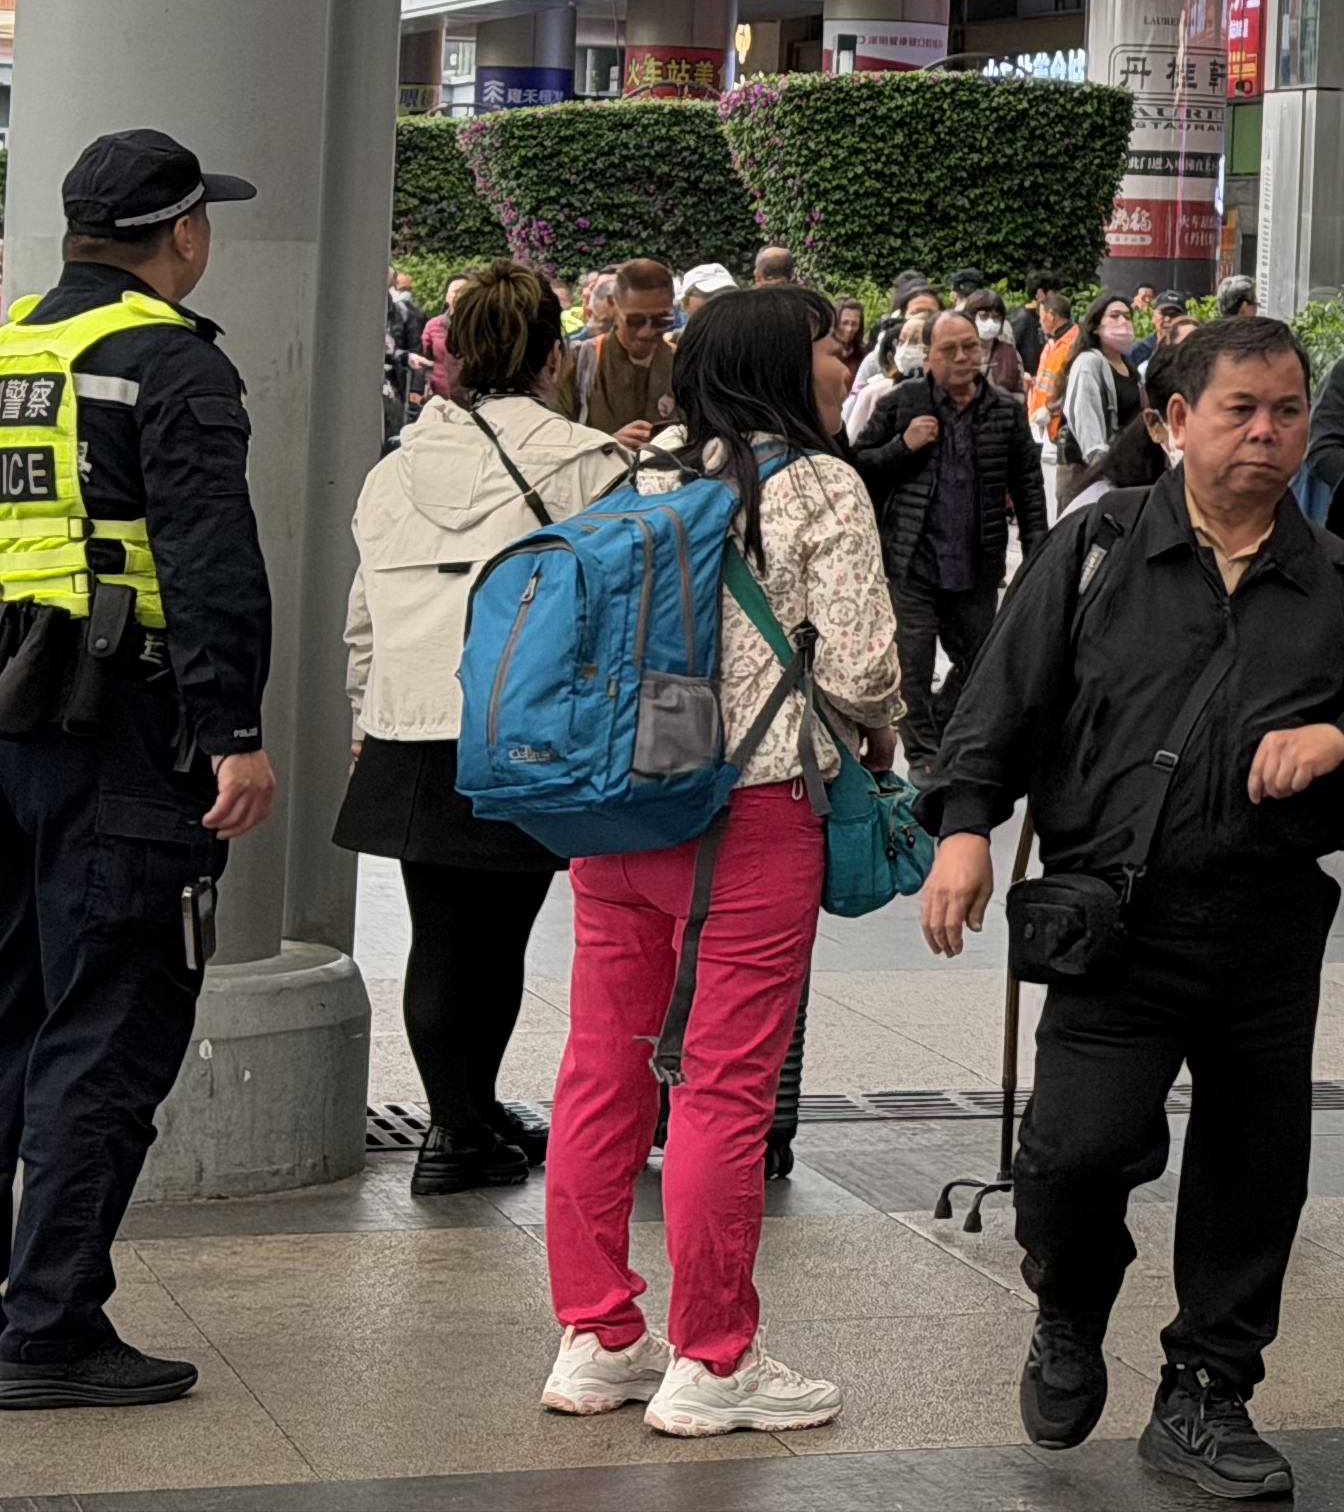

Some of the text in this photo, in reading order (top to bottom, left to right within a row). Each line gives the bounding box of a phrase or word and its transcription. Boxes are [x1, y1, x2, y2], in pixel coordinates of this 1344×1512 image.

[627, 54, 725, 86] 火车站美
[0, 377, 55, 420] 警察
